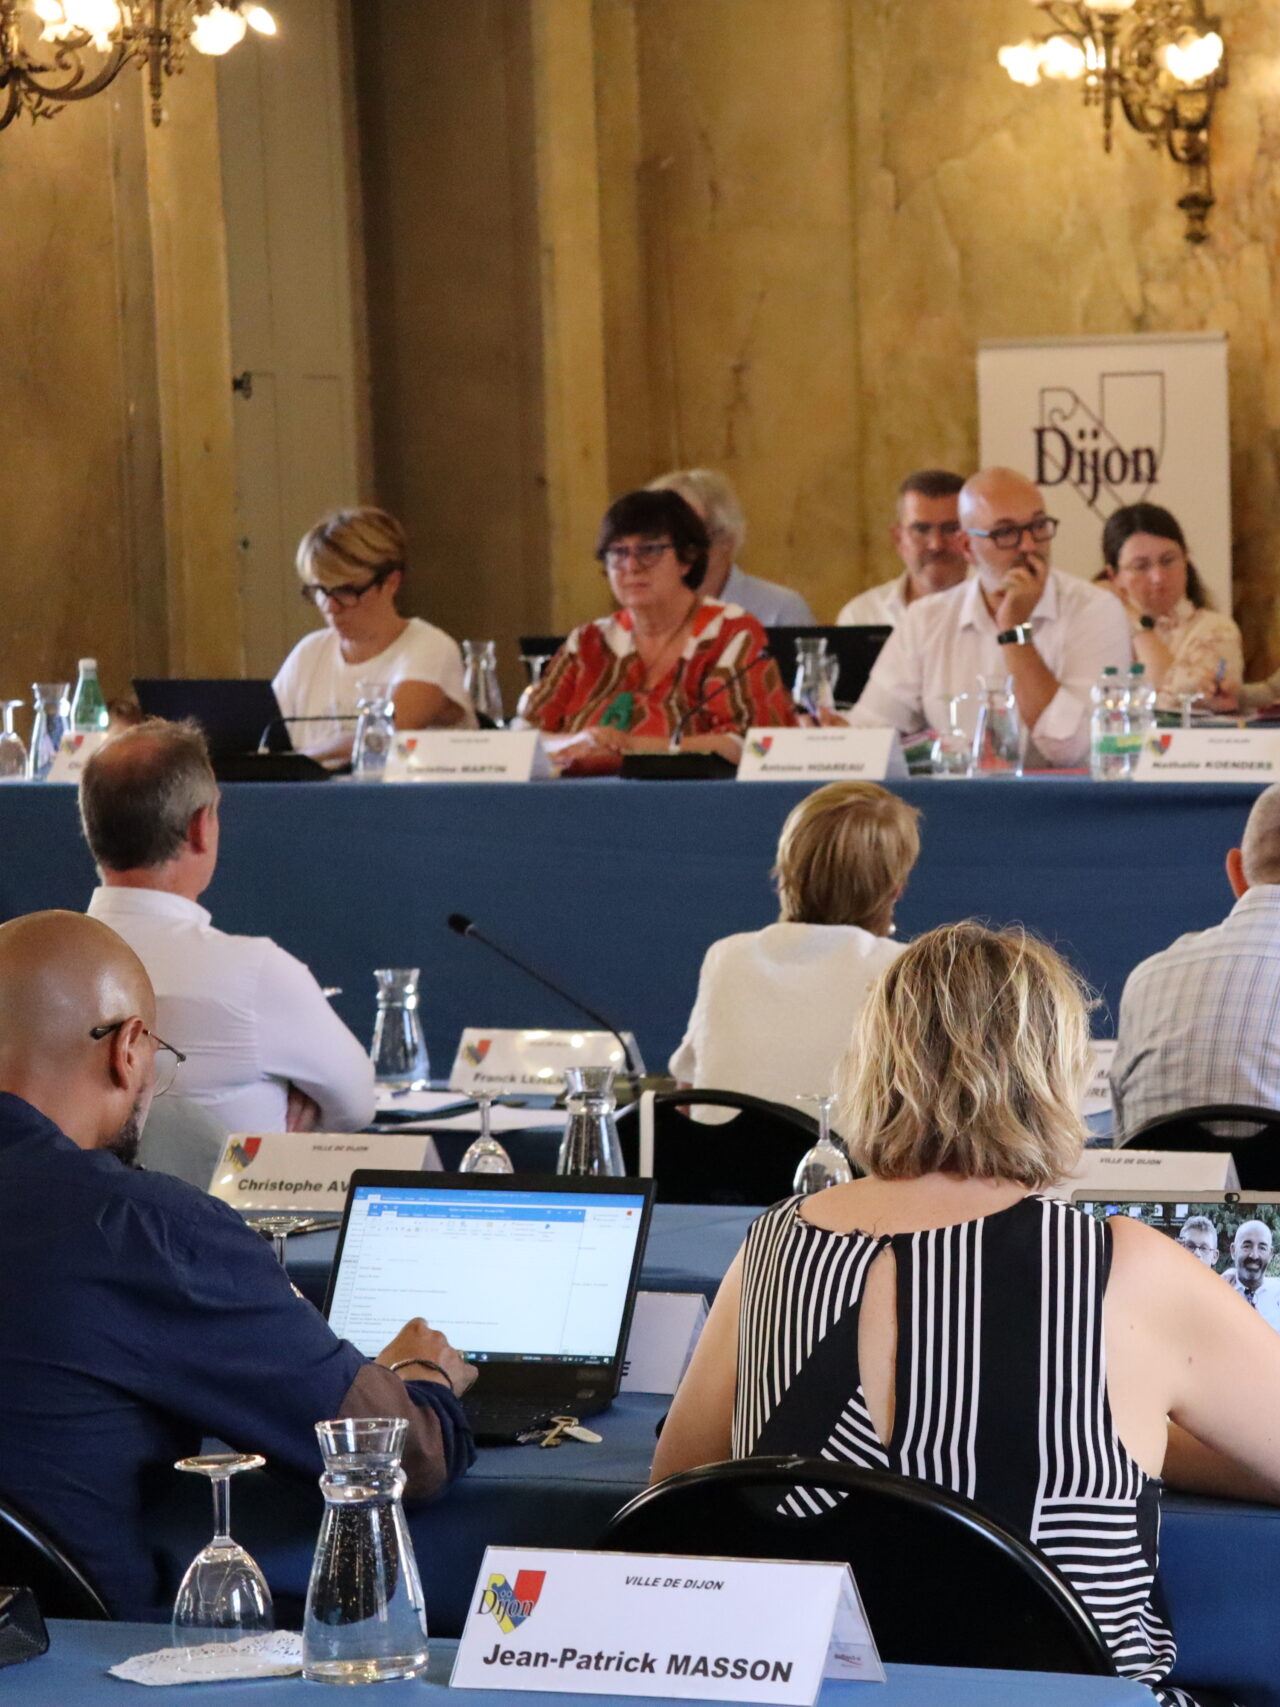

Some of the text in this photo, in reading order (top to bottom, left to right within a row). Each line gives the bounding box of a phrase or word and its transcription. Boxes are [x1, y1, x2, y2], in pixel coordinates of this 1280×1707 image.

[1033, 427, 1160, 507] Dijon
[1205, 761, 1273, 770] KOENDERS
[472, 1073, 516, 1084] Franck
[238, 1179, 323, 1195] Christophe
[625, 1575, 725, 1591] VILLE DE DIJON
[475, 1589, 533, 1624] Dijon
[482, 1644, 793, 1683] Jean-Patrick MASSON
